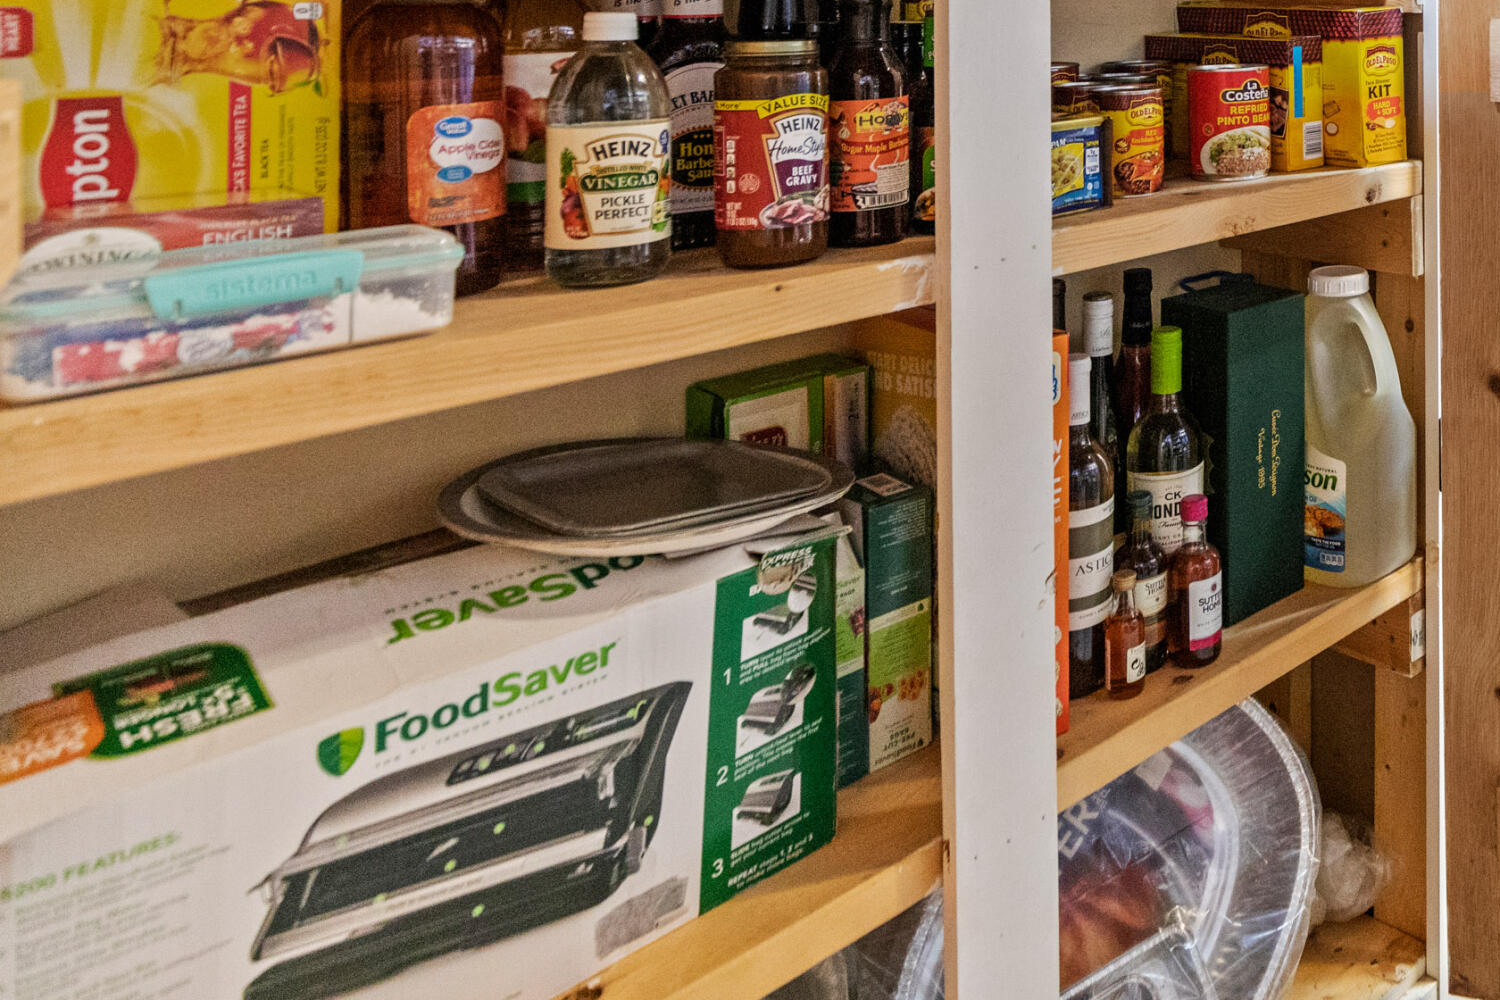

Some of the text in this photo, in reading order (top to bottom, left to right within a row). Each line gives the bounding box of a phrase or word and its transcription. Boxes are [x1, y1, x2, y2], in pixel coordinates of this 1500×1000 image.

[1225, 87, 1270, 102] Costeña
[1246, 81, 1258, 91] La
[1368, 84, 1392, 99] KIT
[761, 94, 828, 114] VALUE SIZE
[1229, 102, 1269, 116] REFRIED
[781, 117, 821, 135] HEINZ
[1217, 115, 1251, 127] PINTO
[232, 94, 248, 168] FAVORITE TEA
[66, 108, 120, 205] pton
[438, 142, 477, 155] Apple
[466, 149, 501, 161] Vinega
[591, 139, 652, 161] HEINZ
[792, 163, 814, 177] BEEF
[583, 172, 658, 191] VINEGAR
[785, 172, 819, 188] GRAVY
[600, 193, 647, 209] PICKLE
[594, 205, 651, 221] PERFECT
[202, 223, 294, 247] ENGLISH
[205, 268, 319, 298] sistema
[1164, 490, 1182, 501] CK
[1075, 552, 1114, 577] ASTIC
[387, 553, 648, 648] odSaver
[723, 667, 732, 686] 1
[374, 641, 618, 754] FoodSaver
[715, 764, 729, 787] 2
[711, 857, 725, 879] 3
